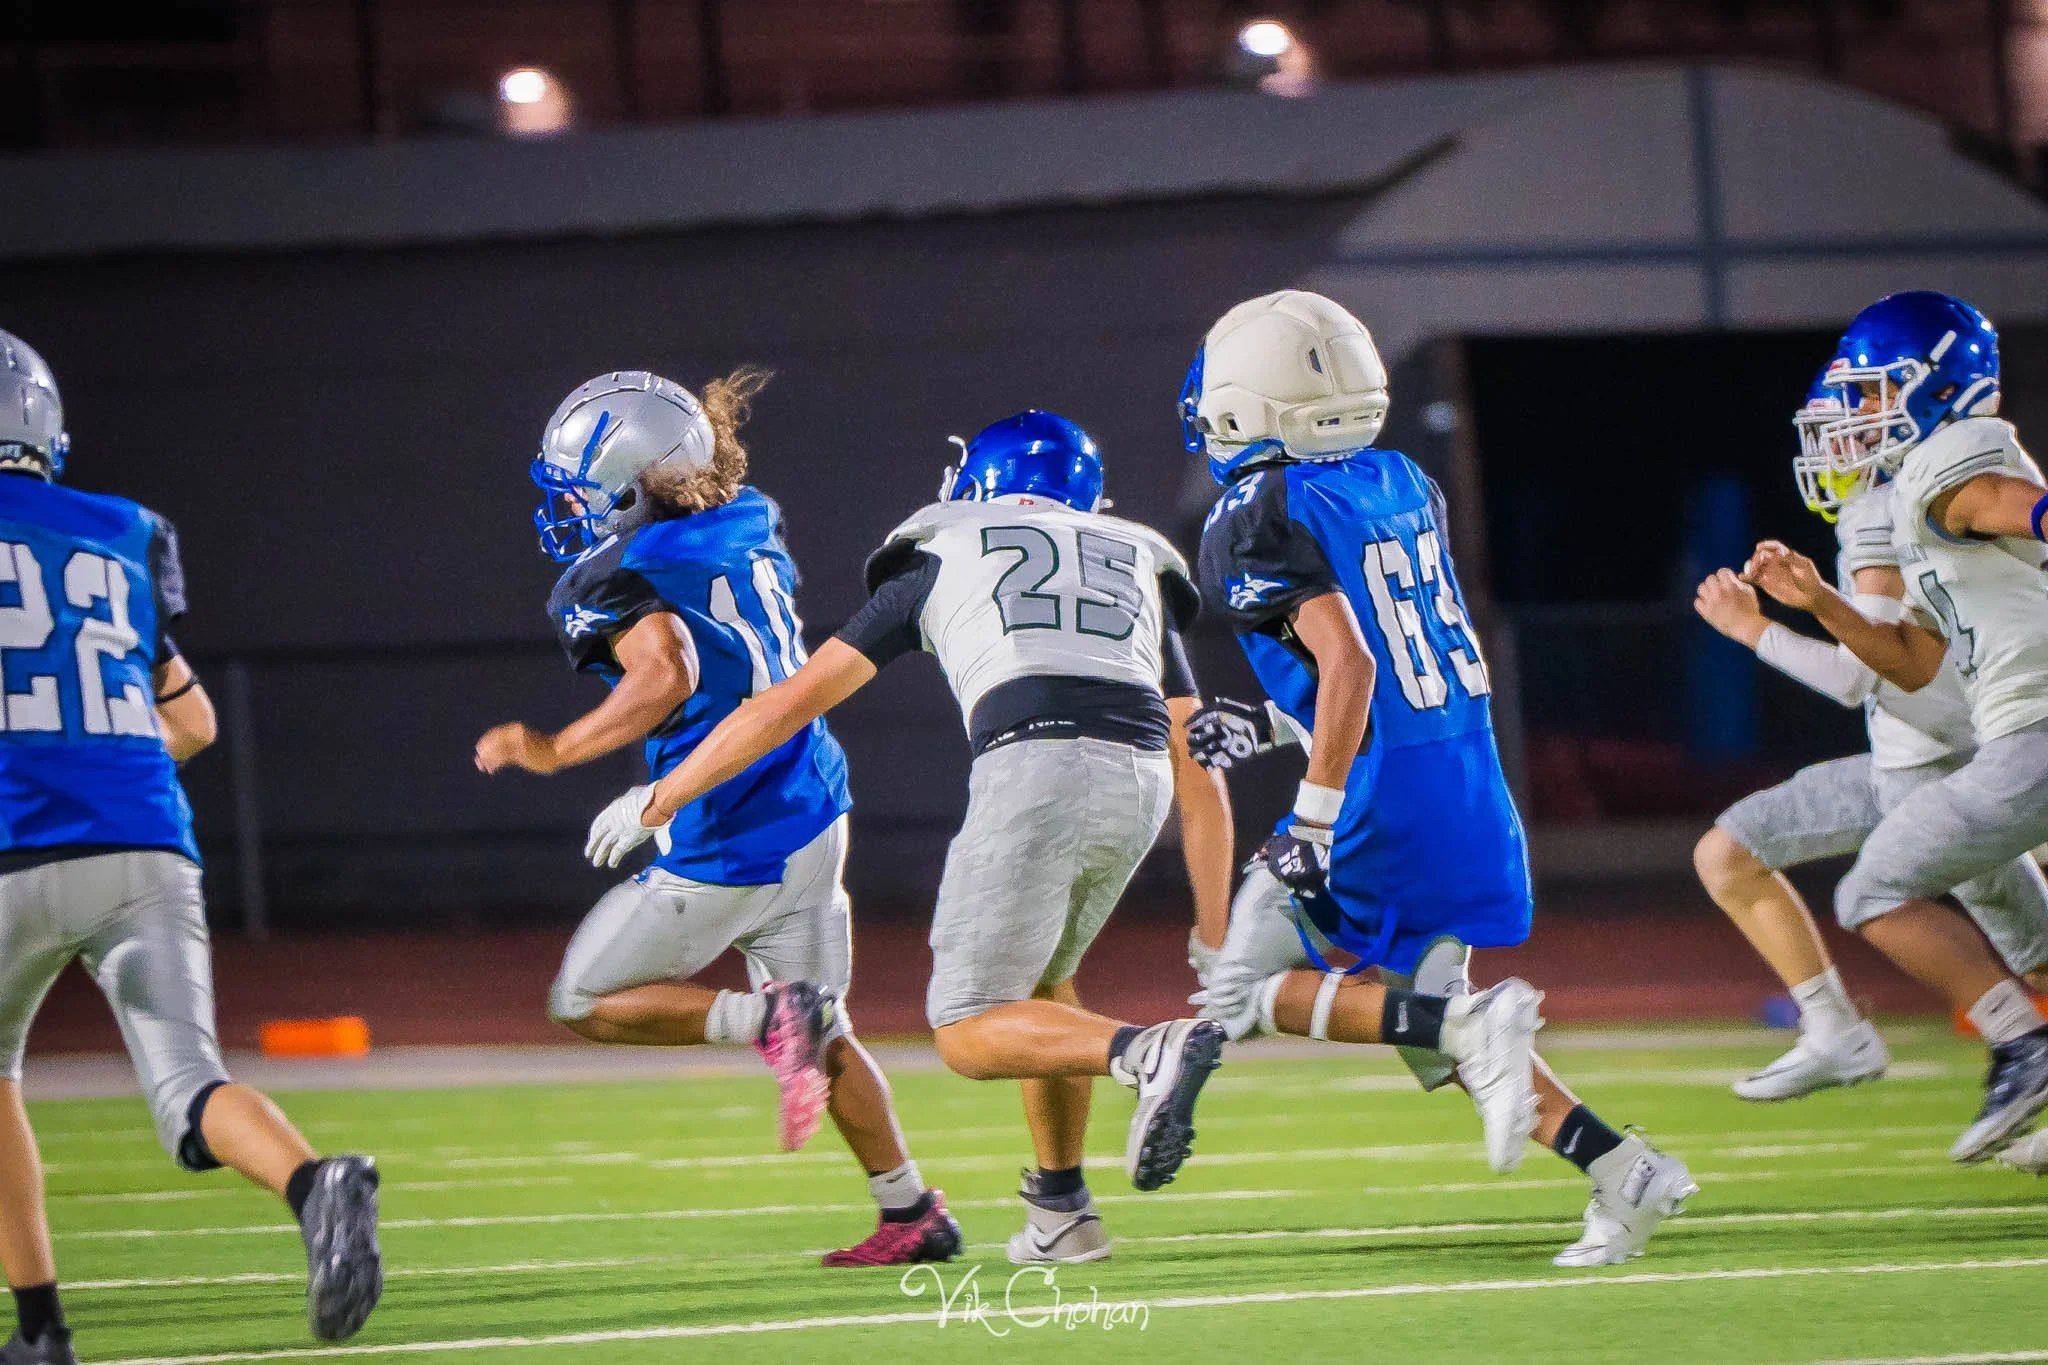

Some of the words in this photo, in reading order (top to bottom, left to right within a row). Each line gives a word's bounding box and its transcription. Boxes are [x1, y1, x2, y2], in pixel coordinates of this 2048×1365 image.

[0, 542, 158, 736] 22
[980, 525, 1144, 641] 25
[1363, 528, 1491, 711] 63
